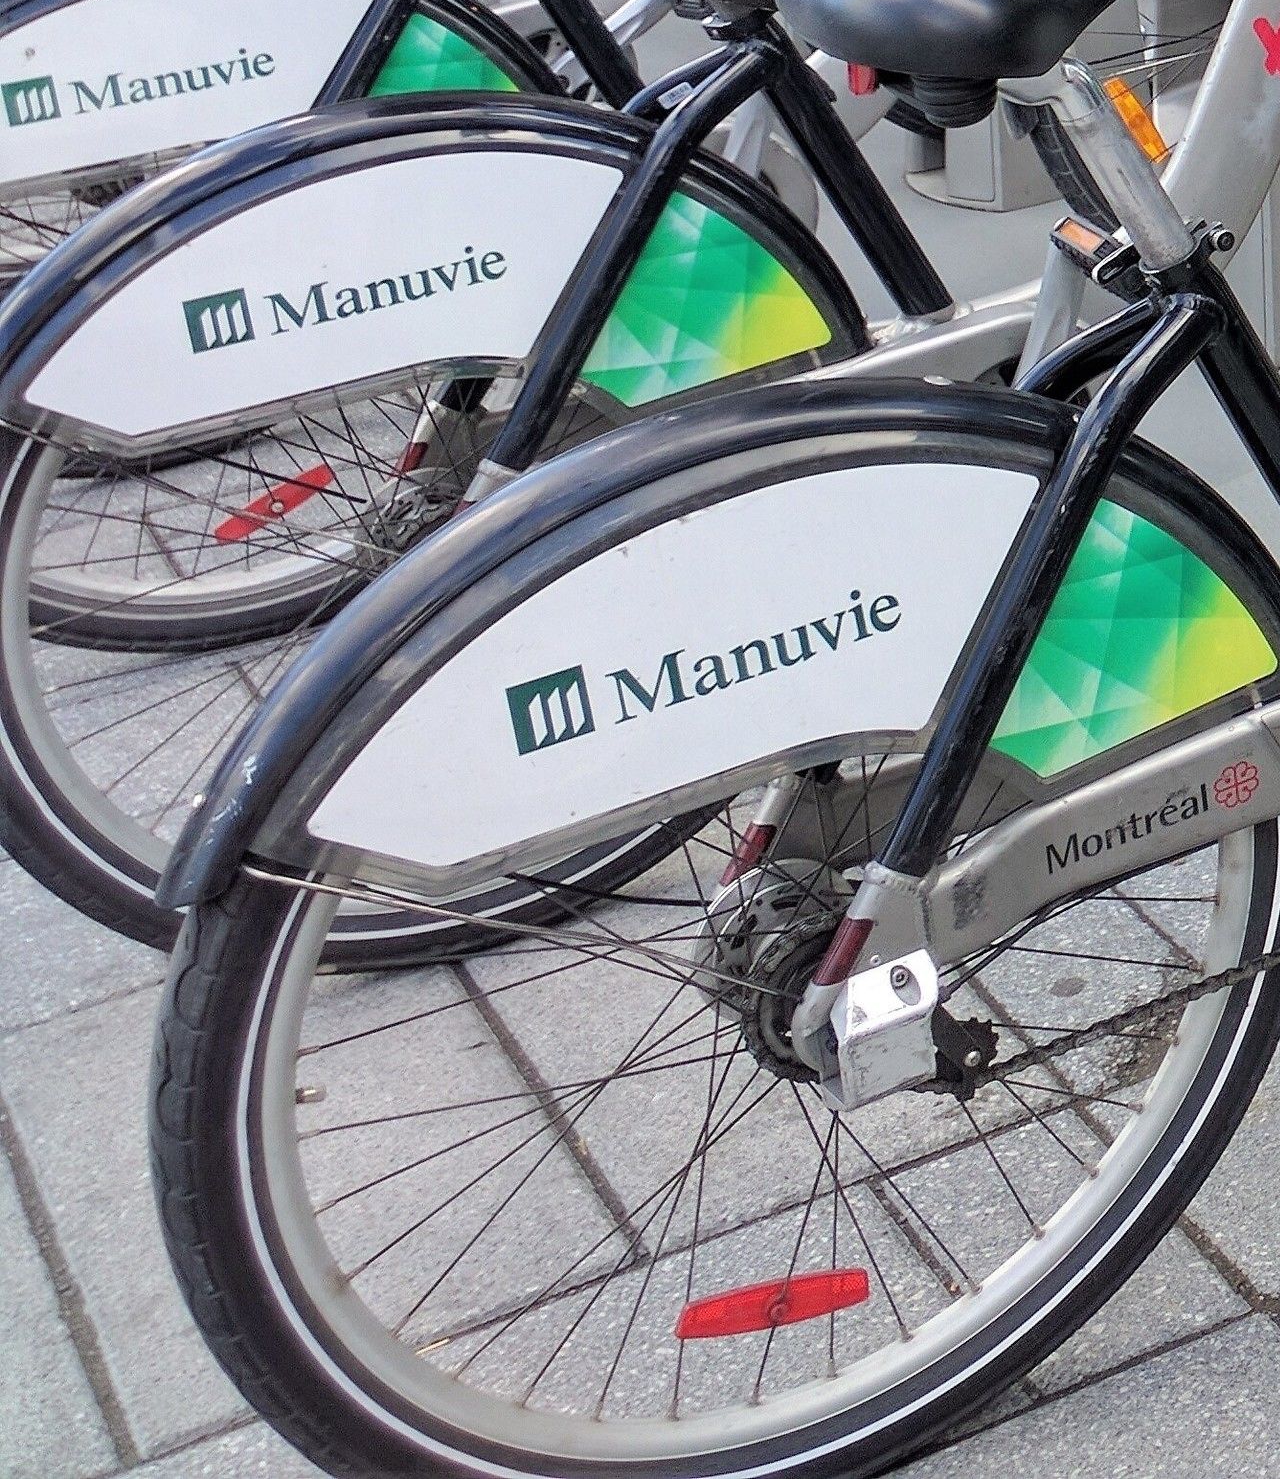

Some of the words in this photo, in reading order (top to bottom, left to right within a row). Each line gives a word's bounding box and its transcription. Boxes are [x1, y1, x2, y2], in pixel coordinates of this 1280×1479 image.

[70, 47, 276, 117] Manuvie
[264, 245, 508, 337] Manuvie
[605, 589, 903, 726] Manuvie
[1044, 783, 1210, 875] Montréal
